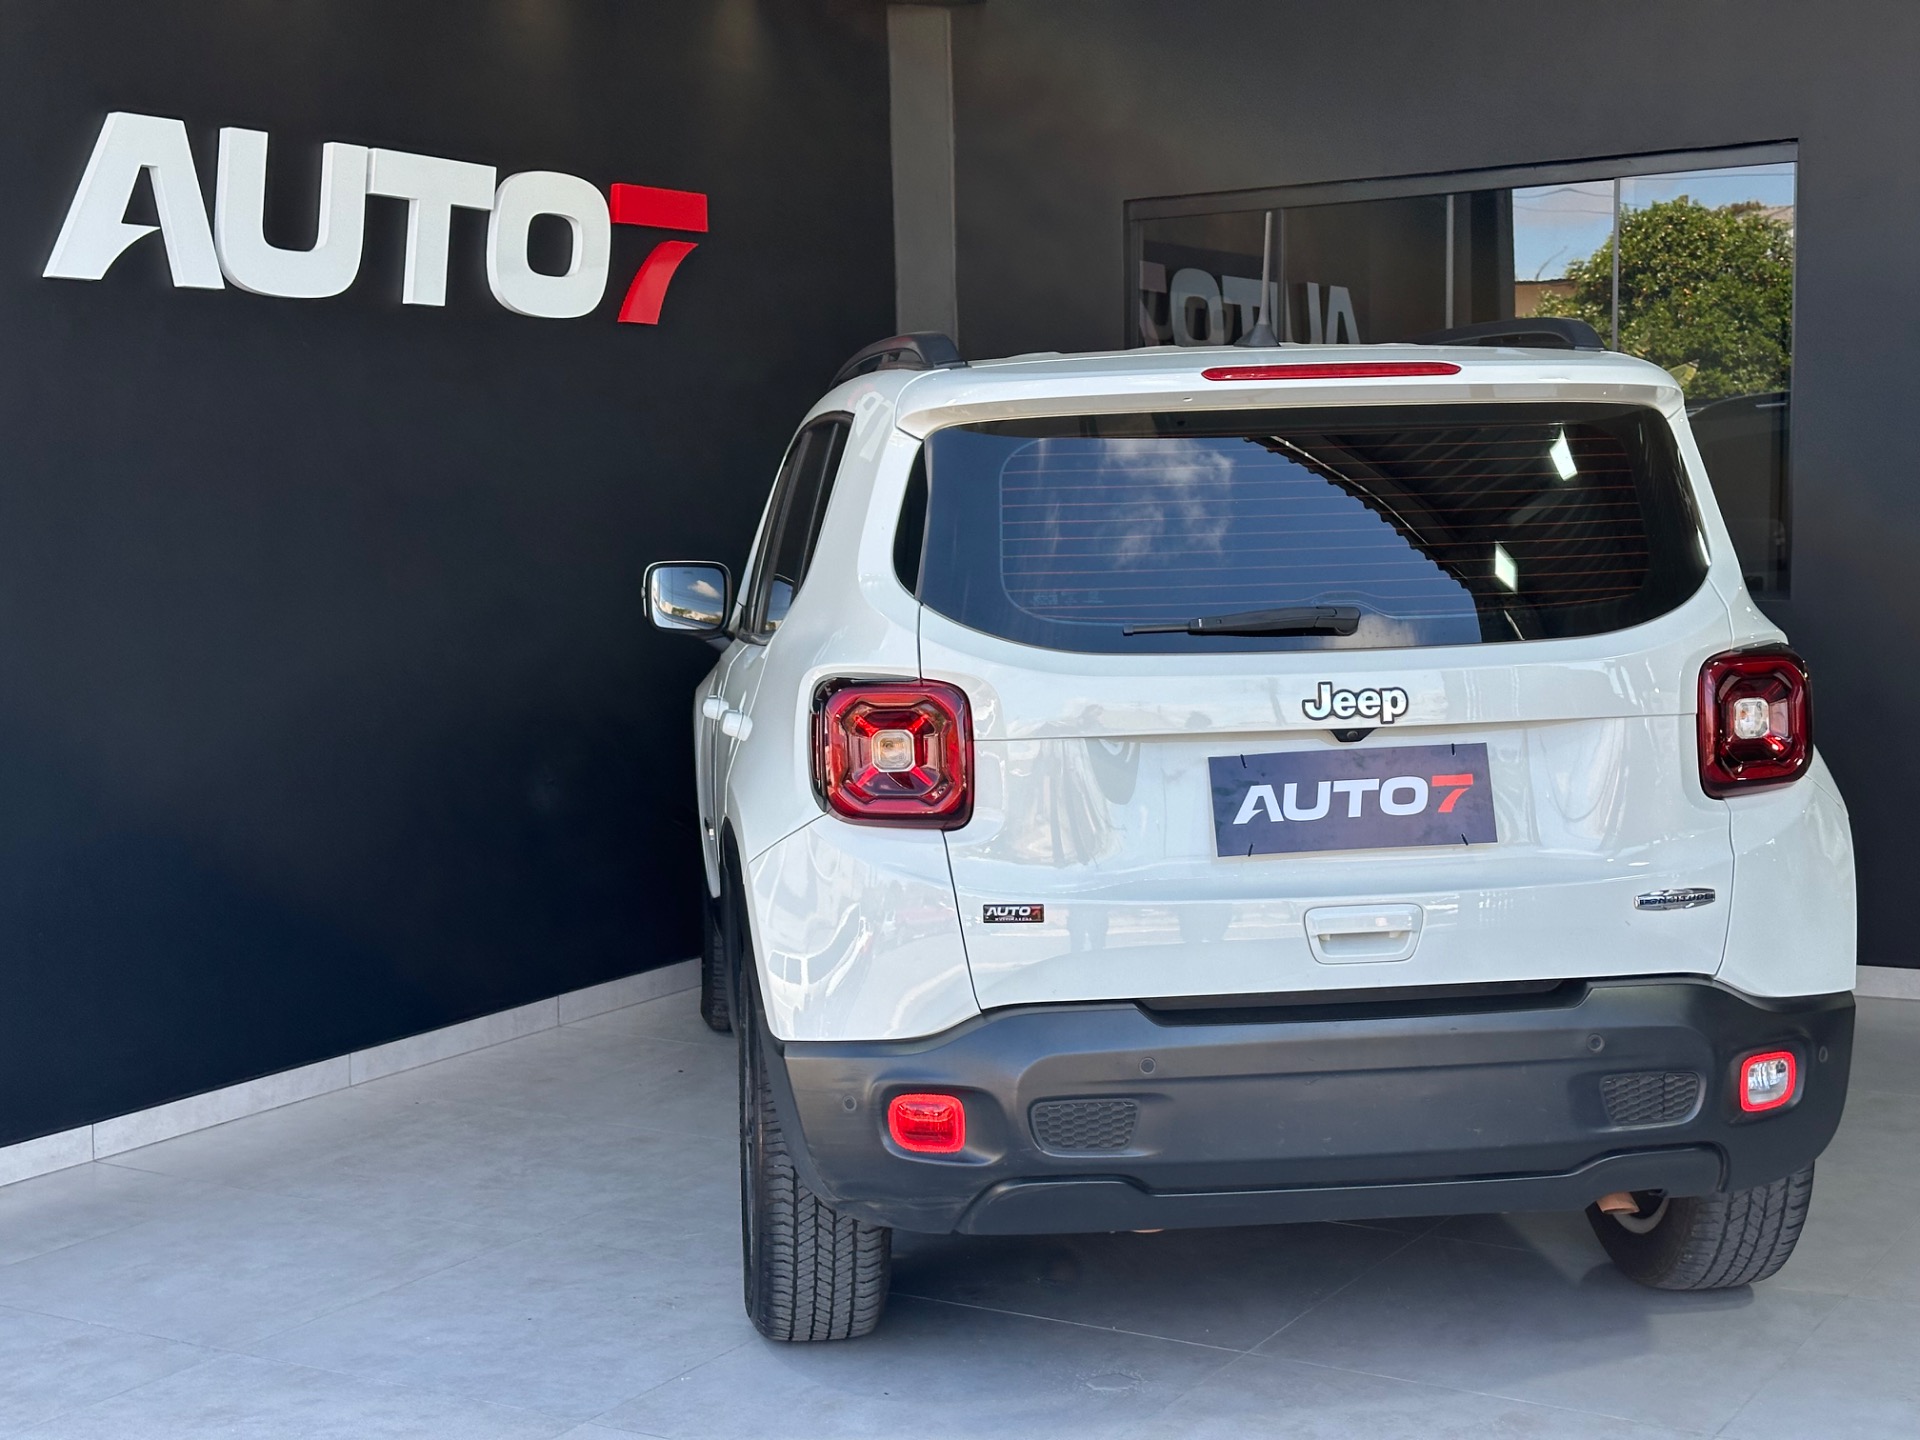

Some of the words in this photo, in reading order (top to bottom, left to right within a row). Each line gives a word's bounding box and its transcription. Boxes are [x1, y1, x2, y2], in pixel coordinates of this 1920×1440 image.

[42, 111, 709, 325] AUTO7
[1302, 681, 1408, 724] Jeep
[1232, 773, 1474, 825] AUTO7
